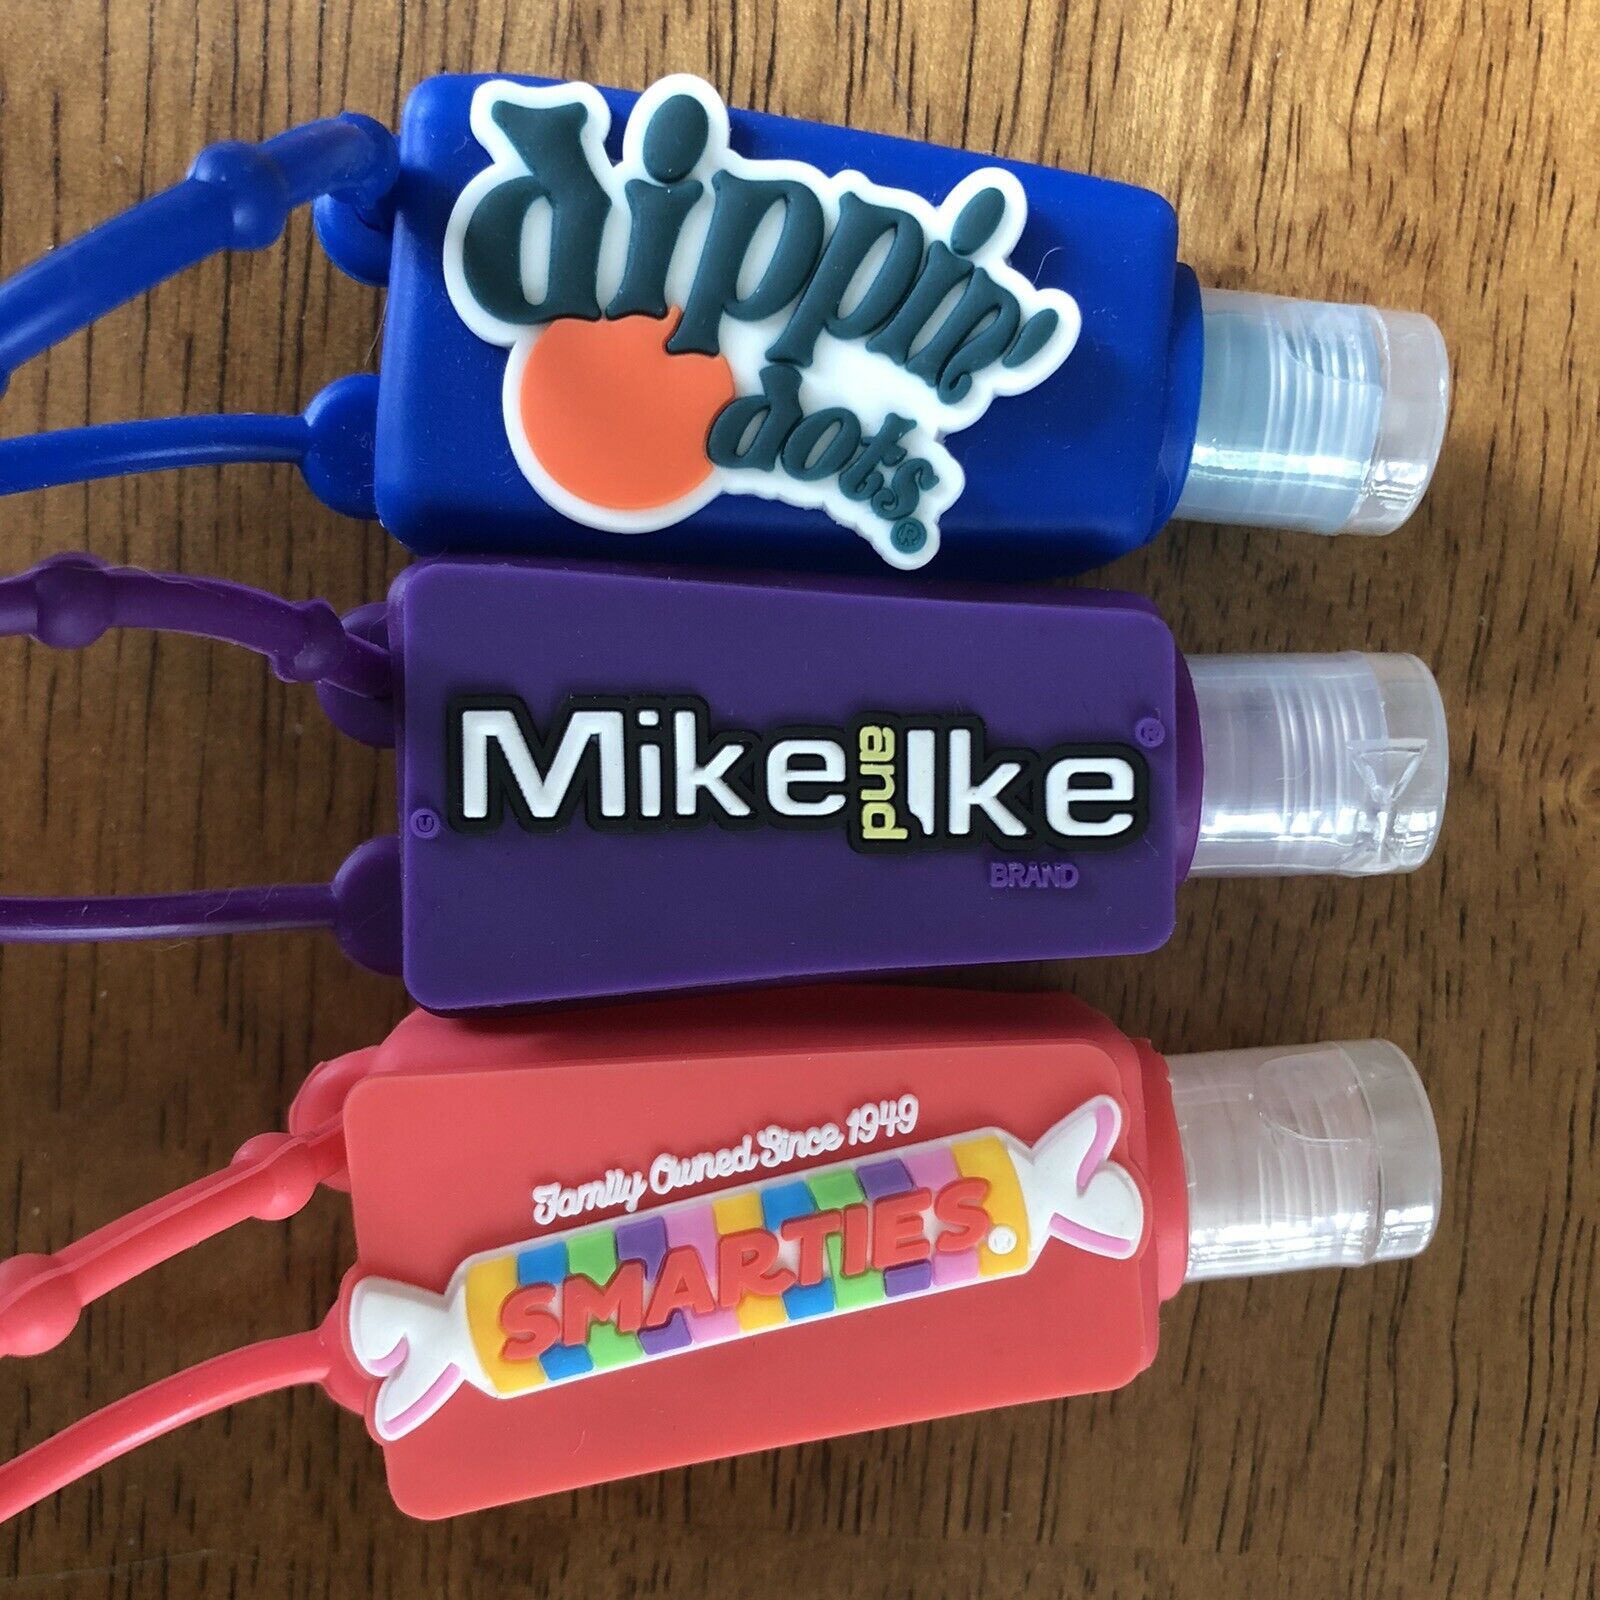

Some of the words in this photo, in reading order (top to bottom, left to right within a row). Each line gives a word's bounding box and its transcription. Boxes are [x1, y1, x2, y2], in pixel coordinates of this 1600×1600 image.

[705, 364, 940, 521] dots
[462, 710, 846, 818] Mike
[859, 725, 908, 841] and
[906, 728, 1135, 836] Ike
[989, 861, 1080, 889] BRAND
[533, 1168, 647, 1226] Family
[649, 1134, 759, 1195] Owned
[757, 1124, 845, 1168] Since
[846, 1093, 919, 1147] 1949
[499, 1177, 992, 1362] SMARTIES
